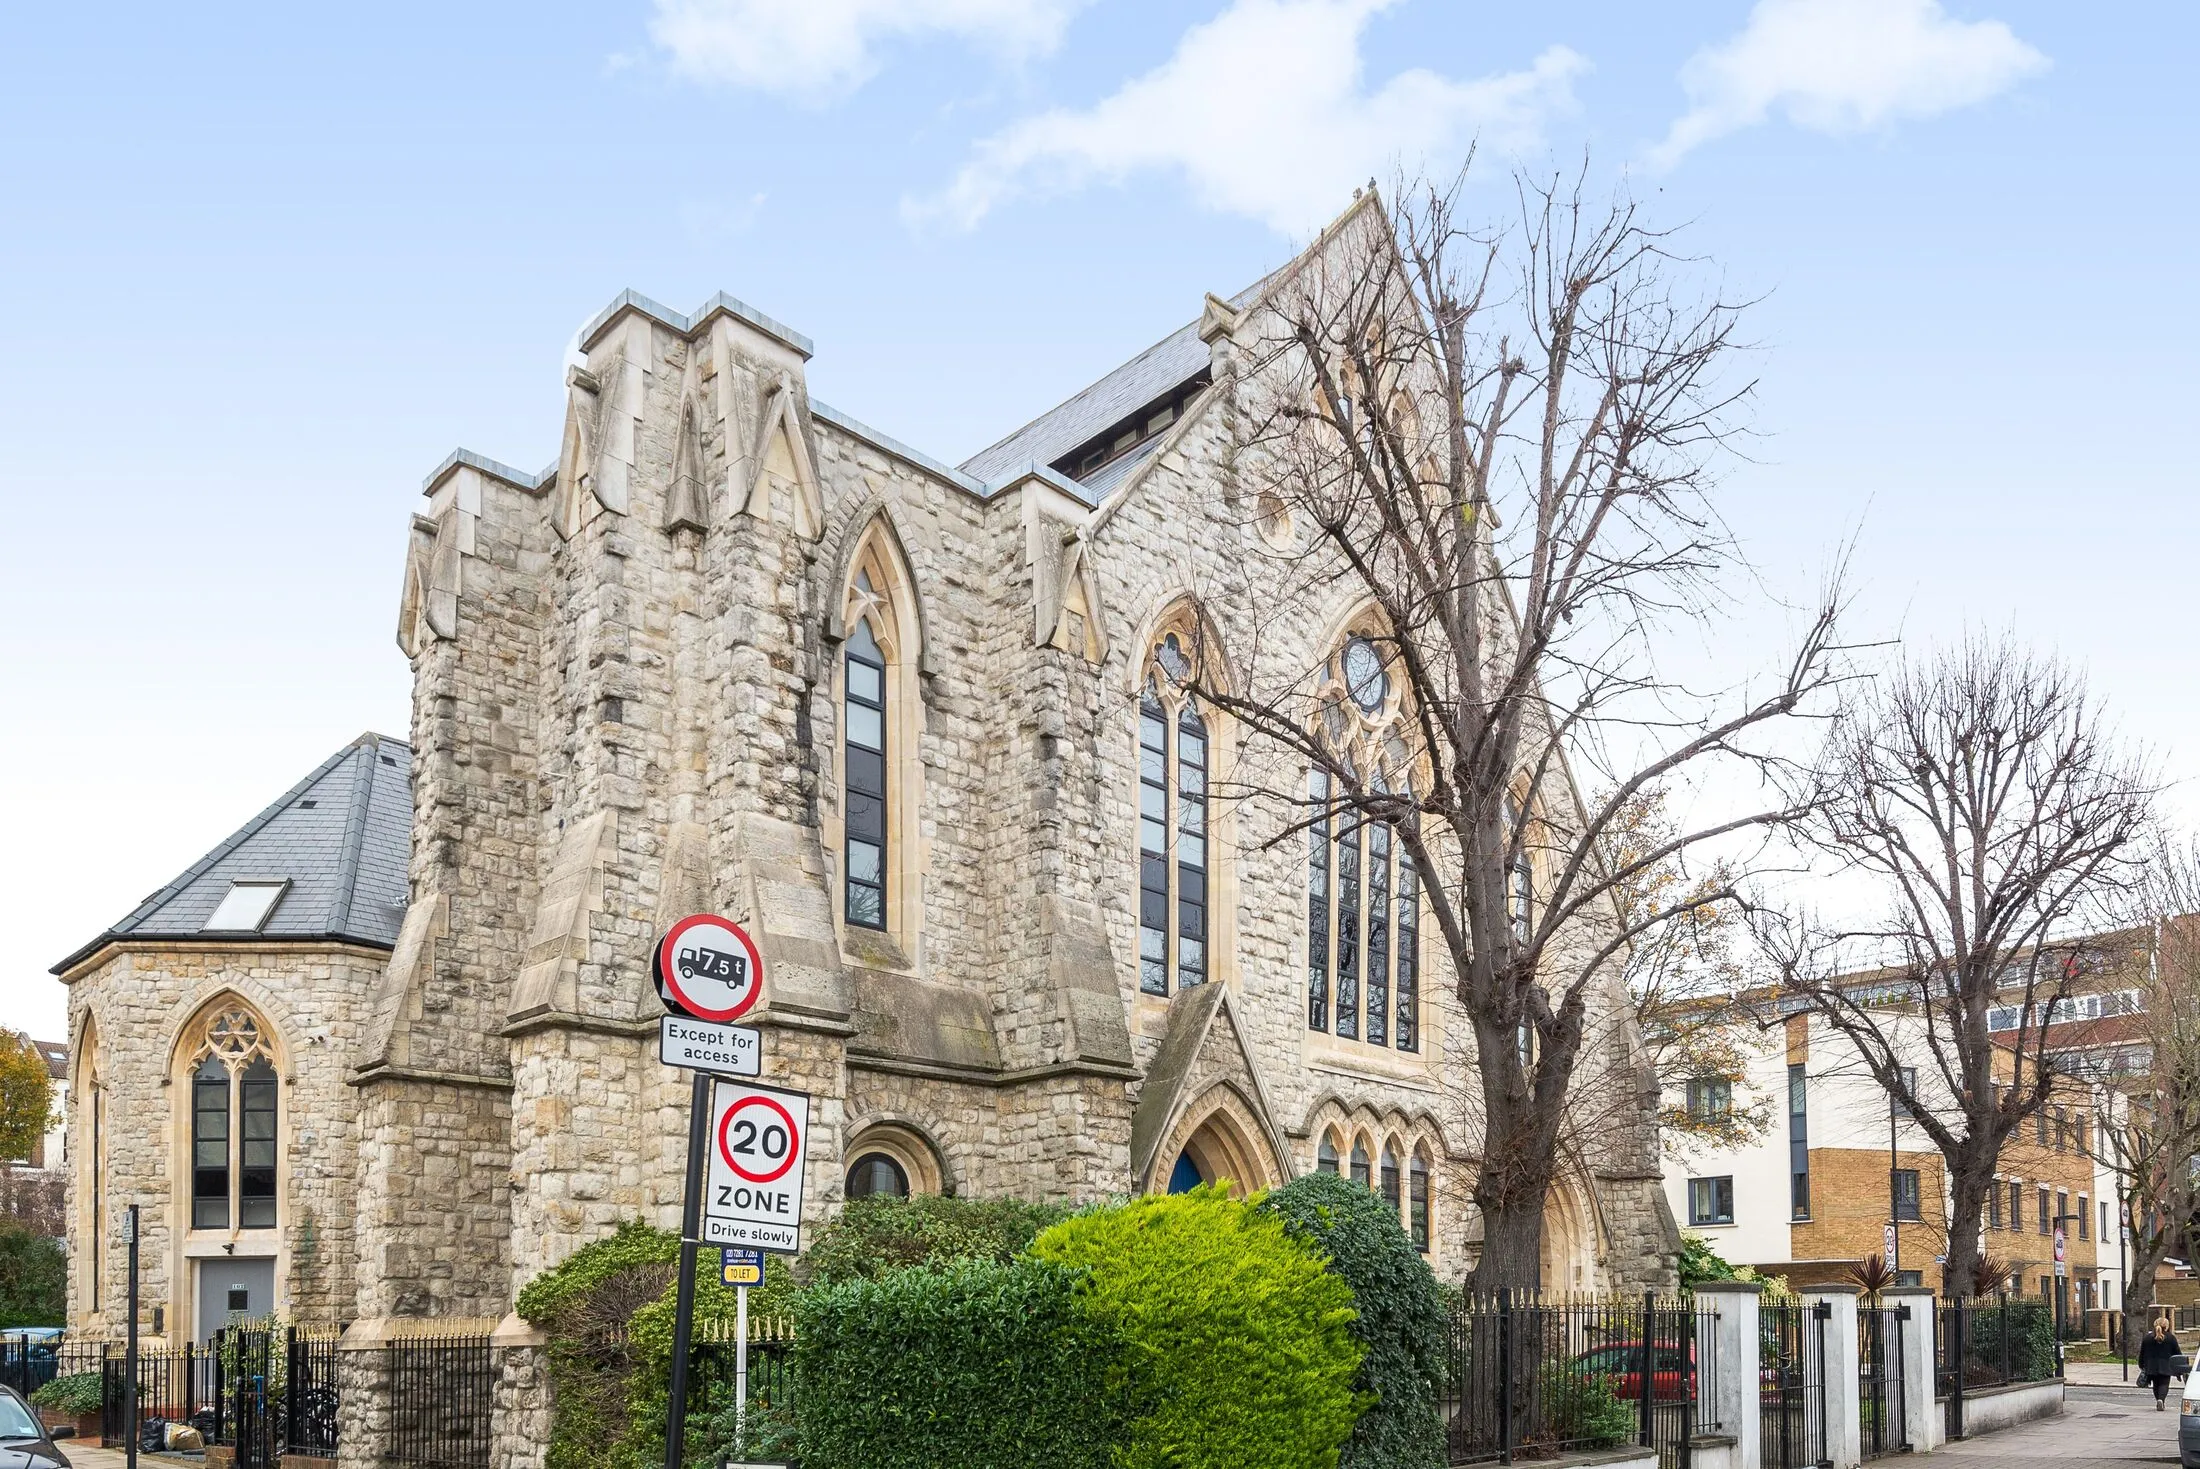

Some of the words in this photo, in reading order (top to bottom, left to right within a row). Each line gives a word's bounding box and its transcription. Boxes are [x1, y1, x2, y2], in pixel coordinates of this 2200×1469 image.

[668, 1023, 724, 1046] Except
[731, 1034, 753, 1050] for
[684, 1047, 739, 1065] access
[733, 1120, 788, 1159] 20
[717, 1185, 790, 1214] ZONE
[711, 1223, 747, 1239] Drive
[751, 1228, 793, 1245] slowly
[730, 1268, 738, 1279] TO
[739, 1268, 751, 1279] LET
